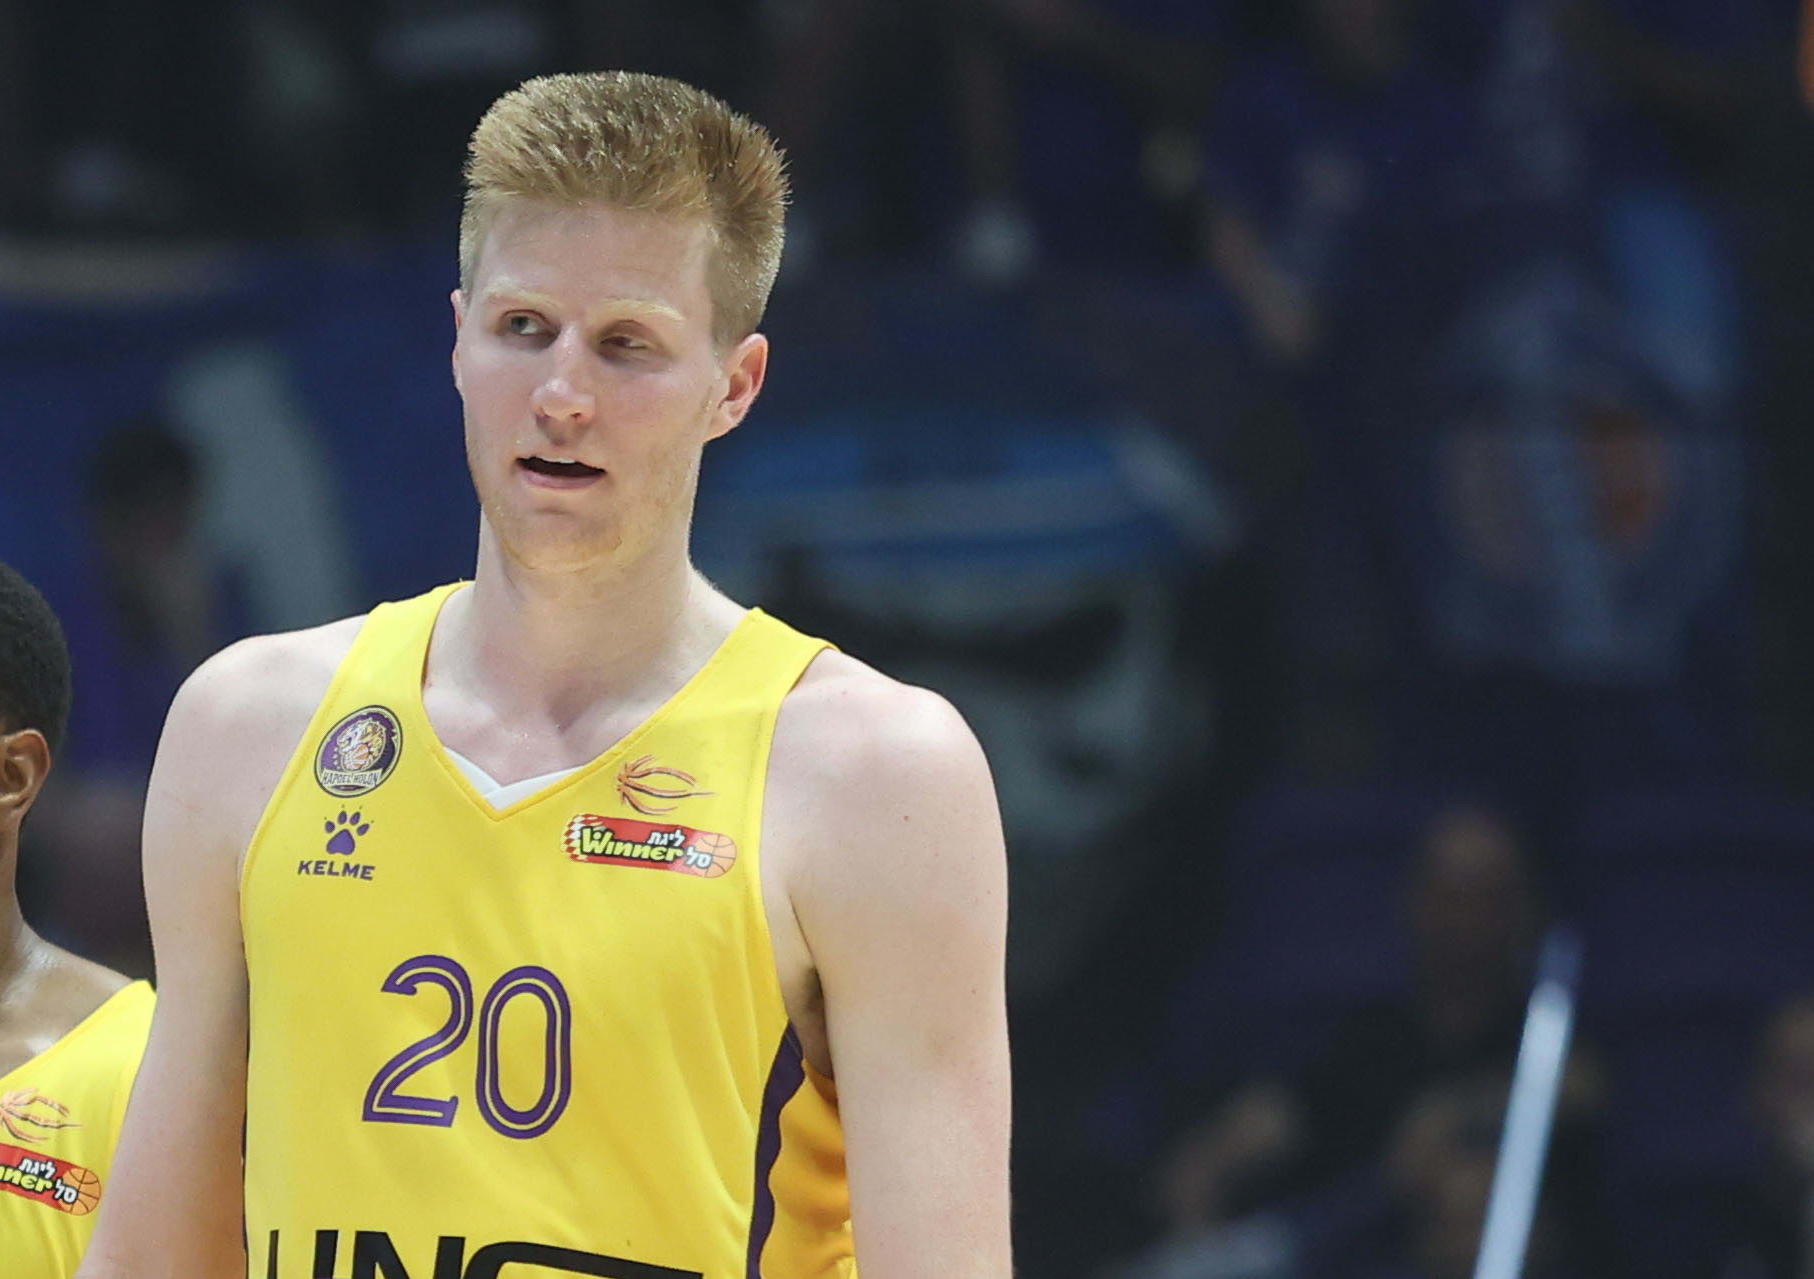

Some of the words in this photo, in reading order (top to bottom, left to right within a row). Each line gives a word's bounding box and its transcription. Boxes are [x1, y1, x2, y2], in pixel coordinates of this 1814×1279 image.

[581, 827, 684, 862] Winner
[686, 846, 712, 869] סל
[297, 859, 375, 881] KELME
[362, 955, 572, 1140] 20
[55, 1179, 78, 1204] סל
